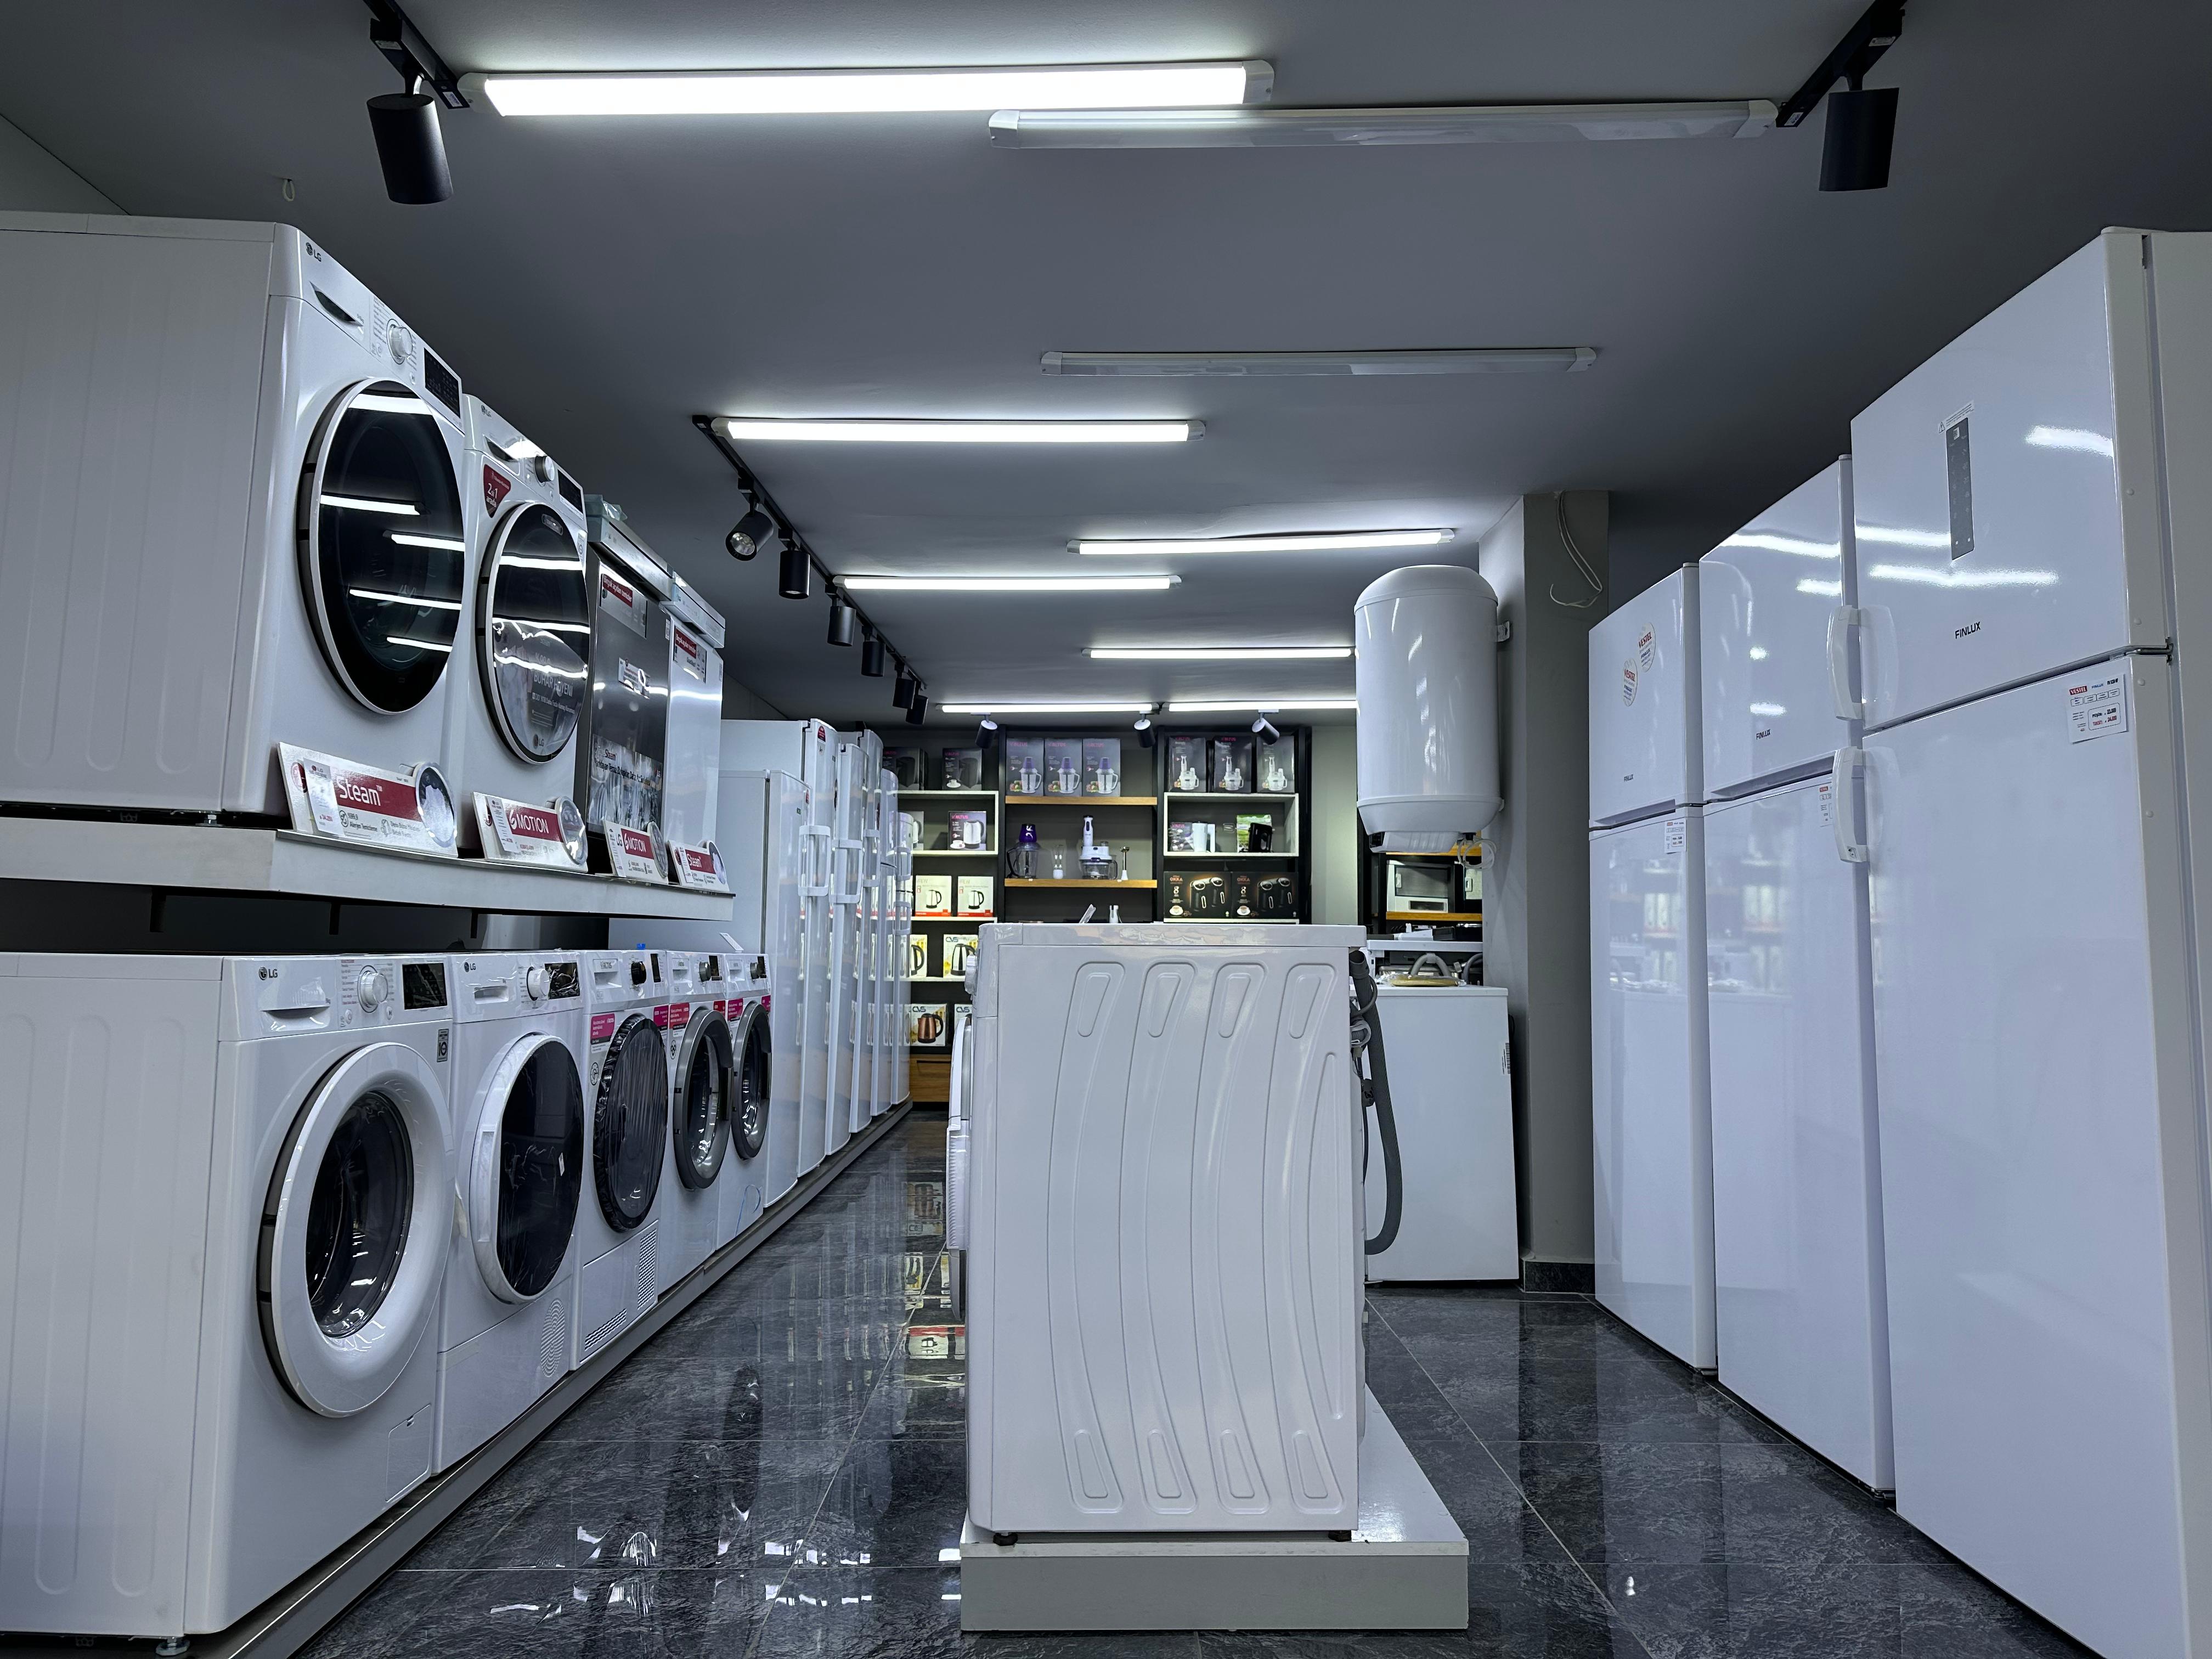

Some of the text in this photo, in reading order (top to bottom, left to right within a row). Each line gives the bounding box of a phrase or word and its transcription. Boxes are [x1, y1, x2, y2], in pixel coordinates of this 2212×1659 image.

[314, 250, 321, 262] LG
[1955, 622, 1981, 639] FINLUX
[1639, 631, 1652, 648] VESTEL
[534, 671, 553, 688] BUHAR
[1624, 669, 1635, 681] VESTEL
[2070, 686, 2086, 695] VESTEL
[1756, 729, 1770, 740] FINLUX
[539, 737, 544, 747] LG
[516, 814, 549, 834] MOTION
[628, 837, 646, 853] MOTION
